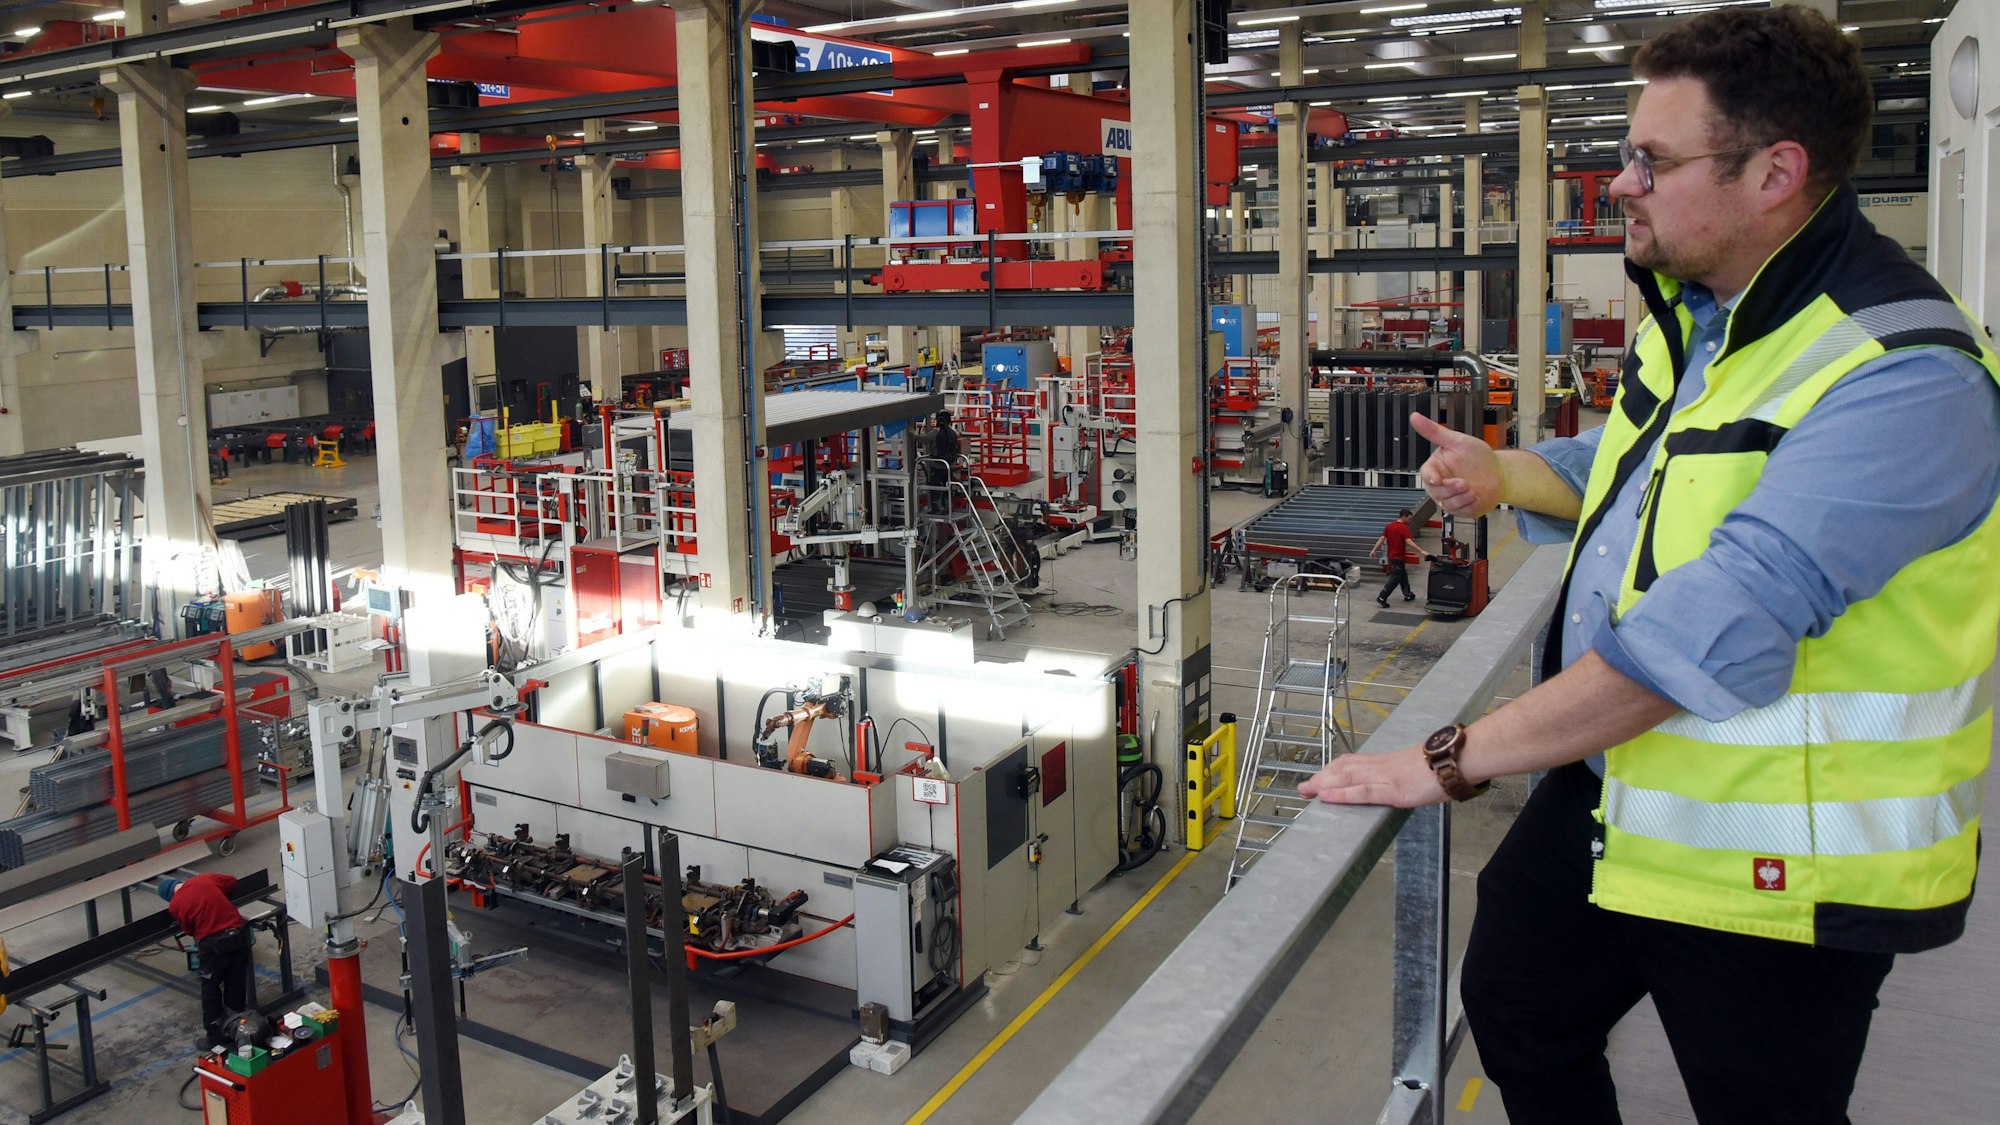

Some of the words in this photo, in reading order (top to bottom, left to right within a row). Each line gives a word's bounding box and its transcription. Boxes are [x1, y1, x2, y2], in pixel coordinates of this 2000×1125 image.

[1106, 127, 1131, 151] ABU
[1872, 195, 1915, 203] DURST
[991, 363, 1019, 373] novus
